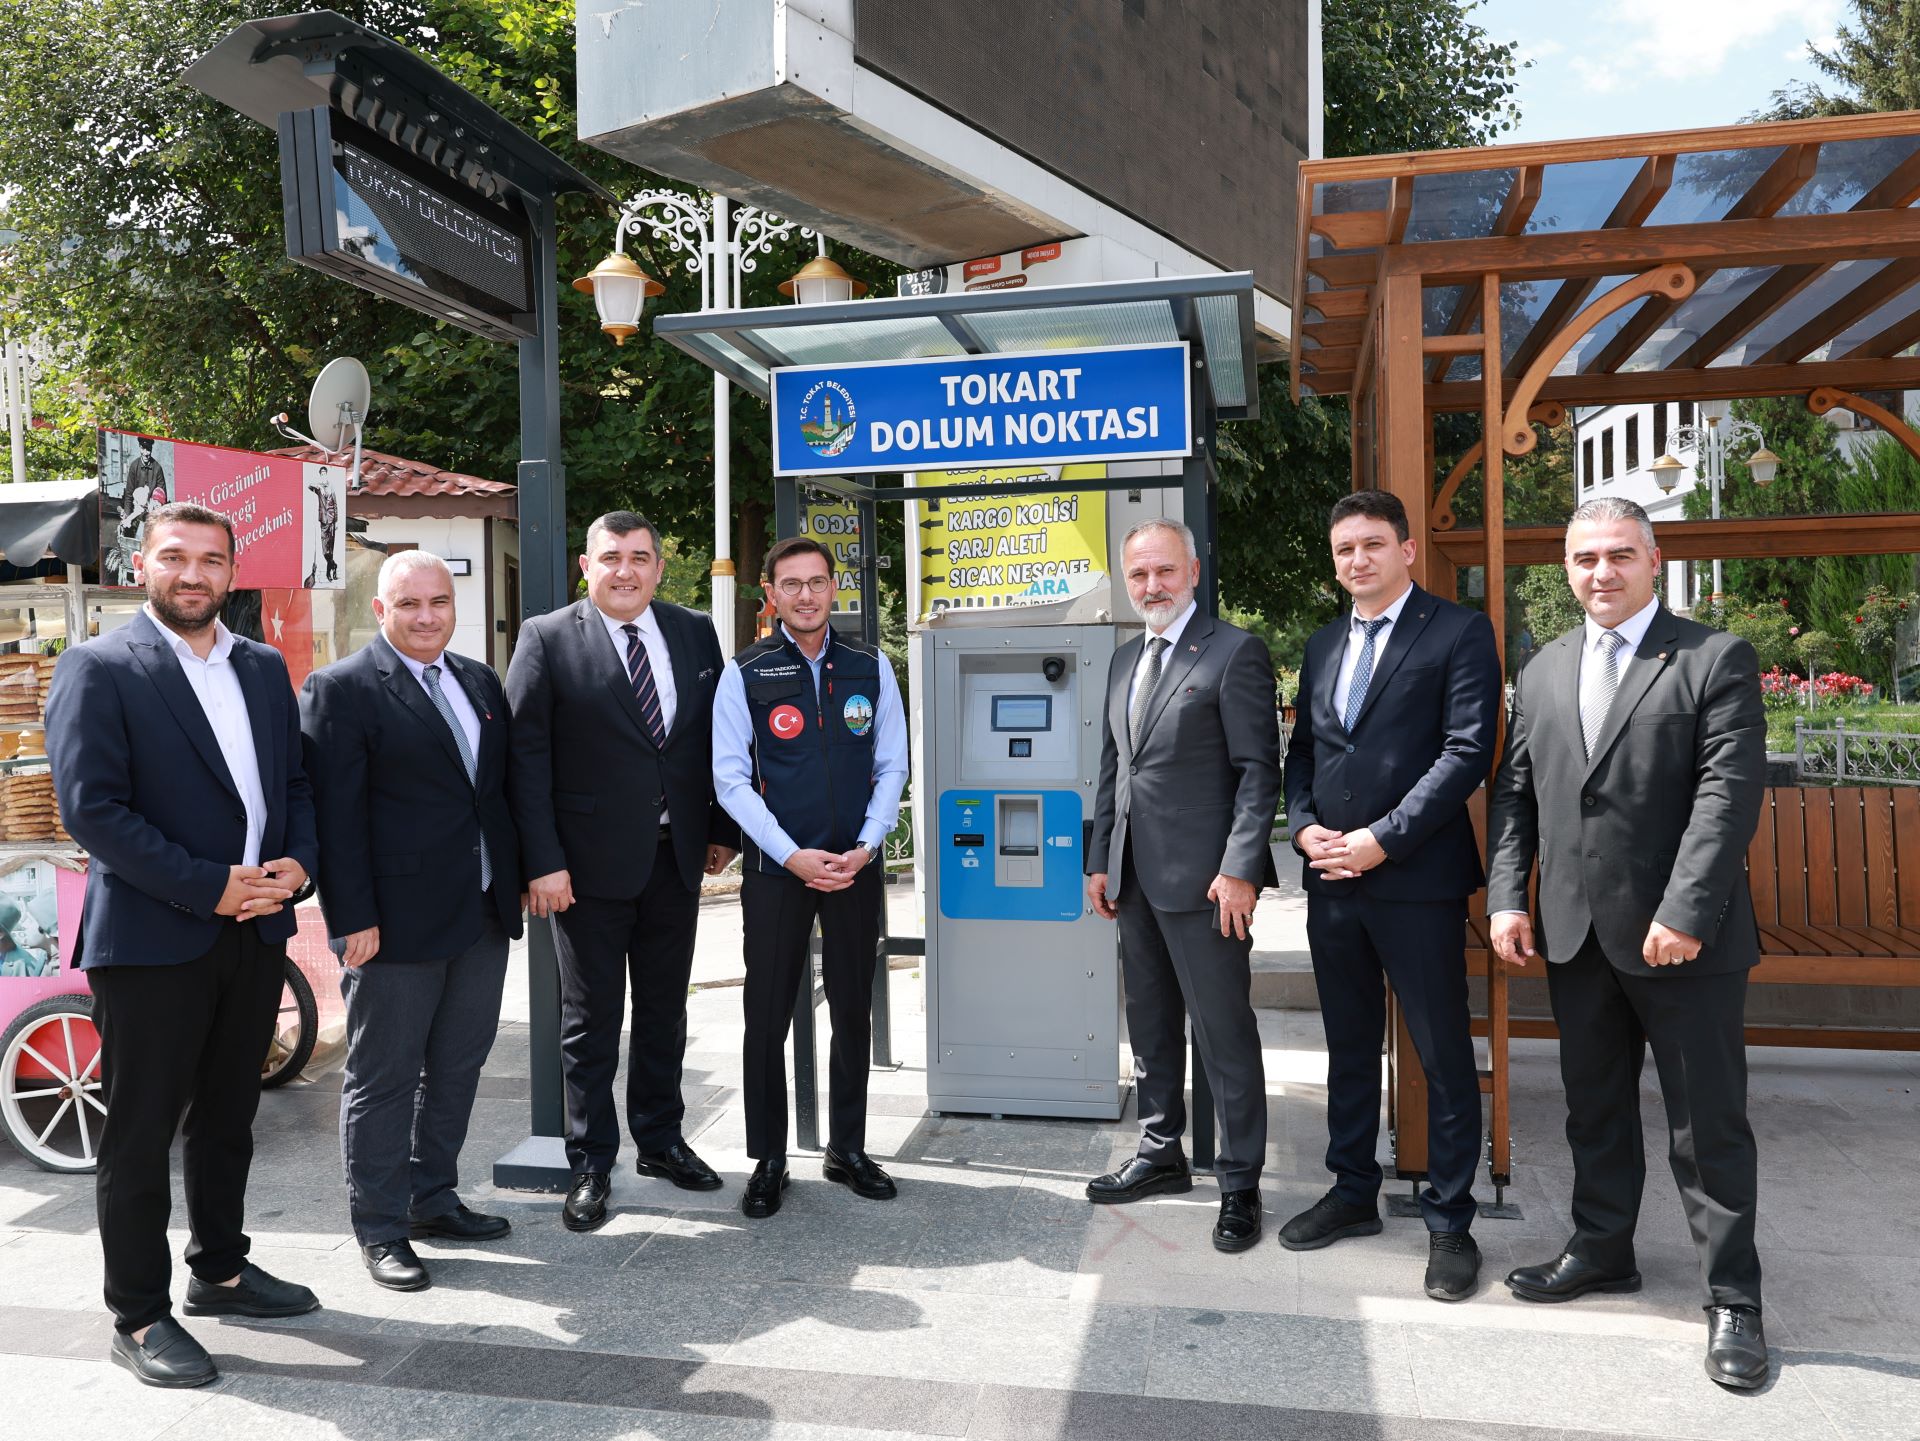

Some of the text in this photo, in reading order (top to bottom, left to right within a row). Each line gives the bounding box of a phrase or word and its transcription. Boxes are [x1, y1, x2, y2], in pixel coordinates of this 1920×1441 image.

[345, 149, 518, 265] TOKAT BELEDİYESİ
[803, 381, 824, 404] TOKAT
[826, 380, 857, 418] BELEDİYESİ
[940, 368, 1082, 407] TOKART
[870, 405, 1159, 453] DOLUM NOKTASI
[210, 465, 271, 505] Gözümün
[226, 496, 257, 529] içeği
[233, 507, 293, 555] iyecekmiş
[947, 495, 1078, 532] KARGO KOLİSİ
[948, 527, 1047, 564] ŞARJ ALETİ
[948, 565, 1004, 588] SICAK
